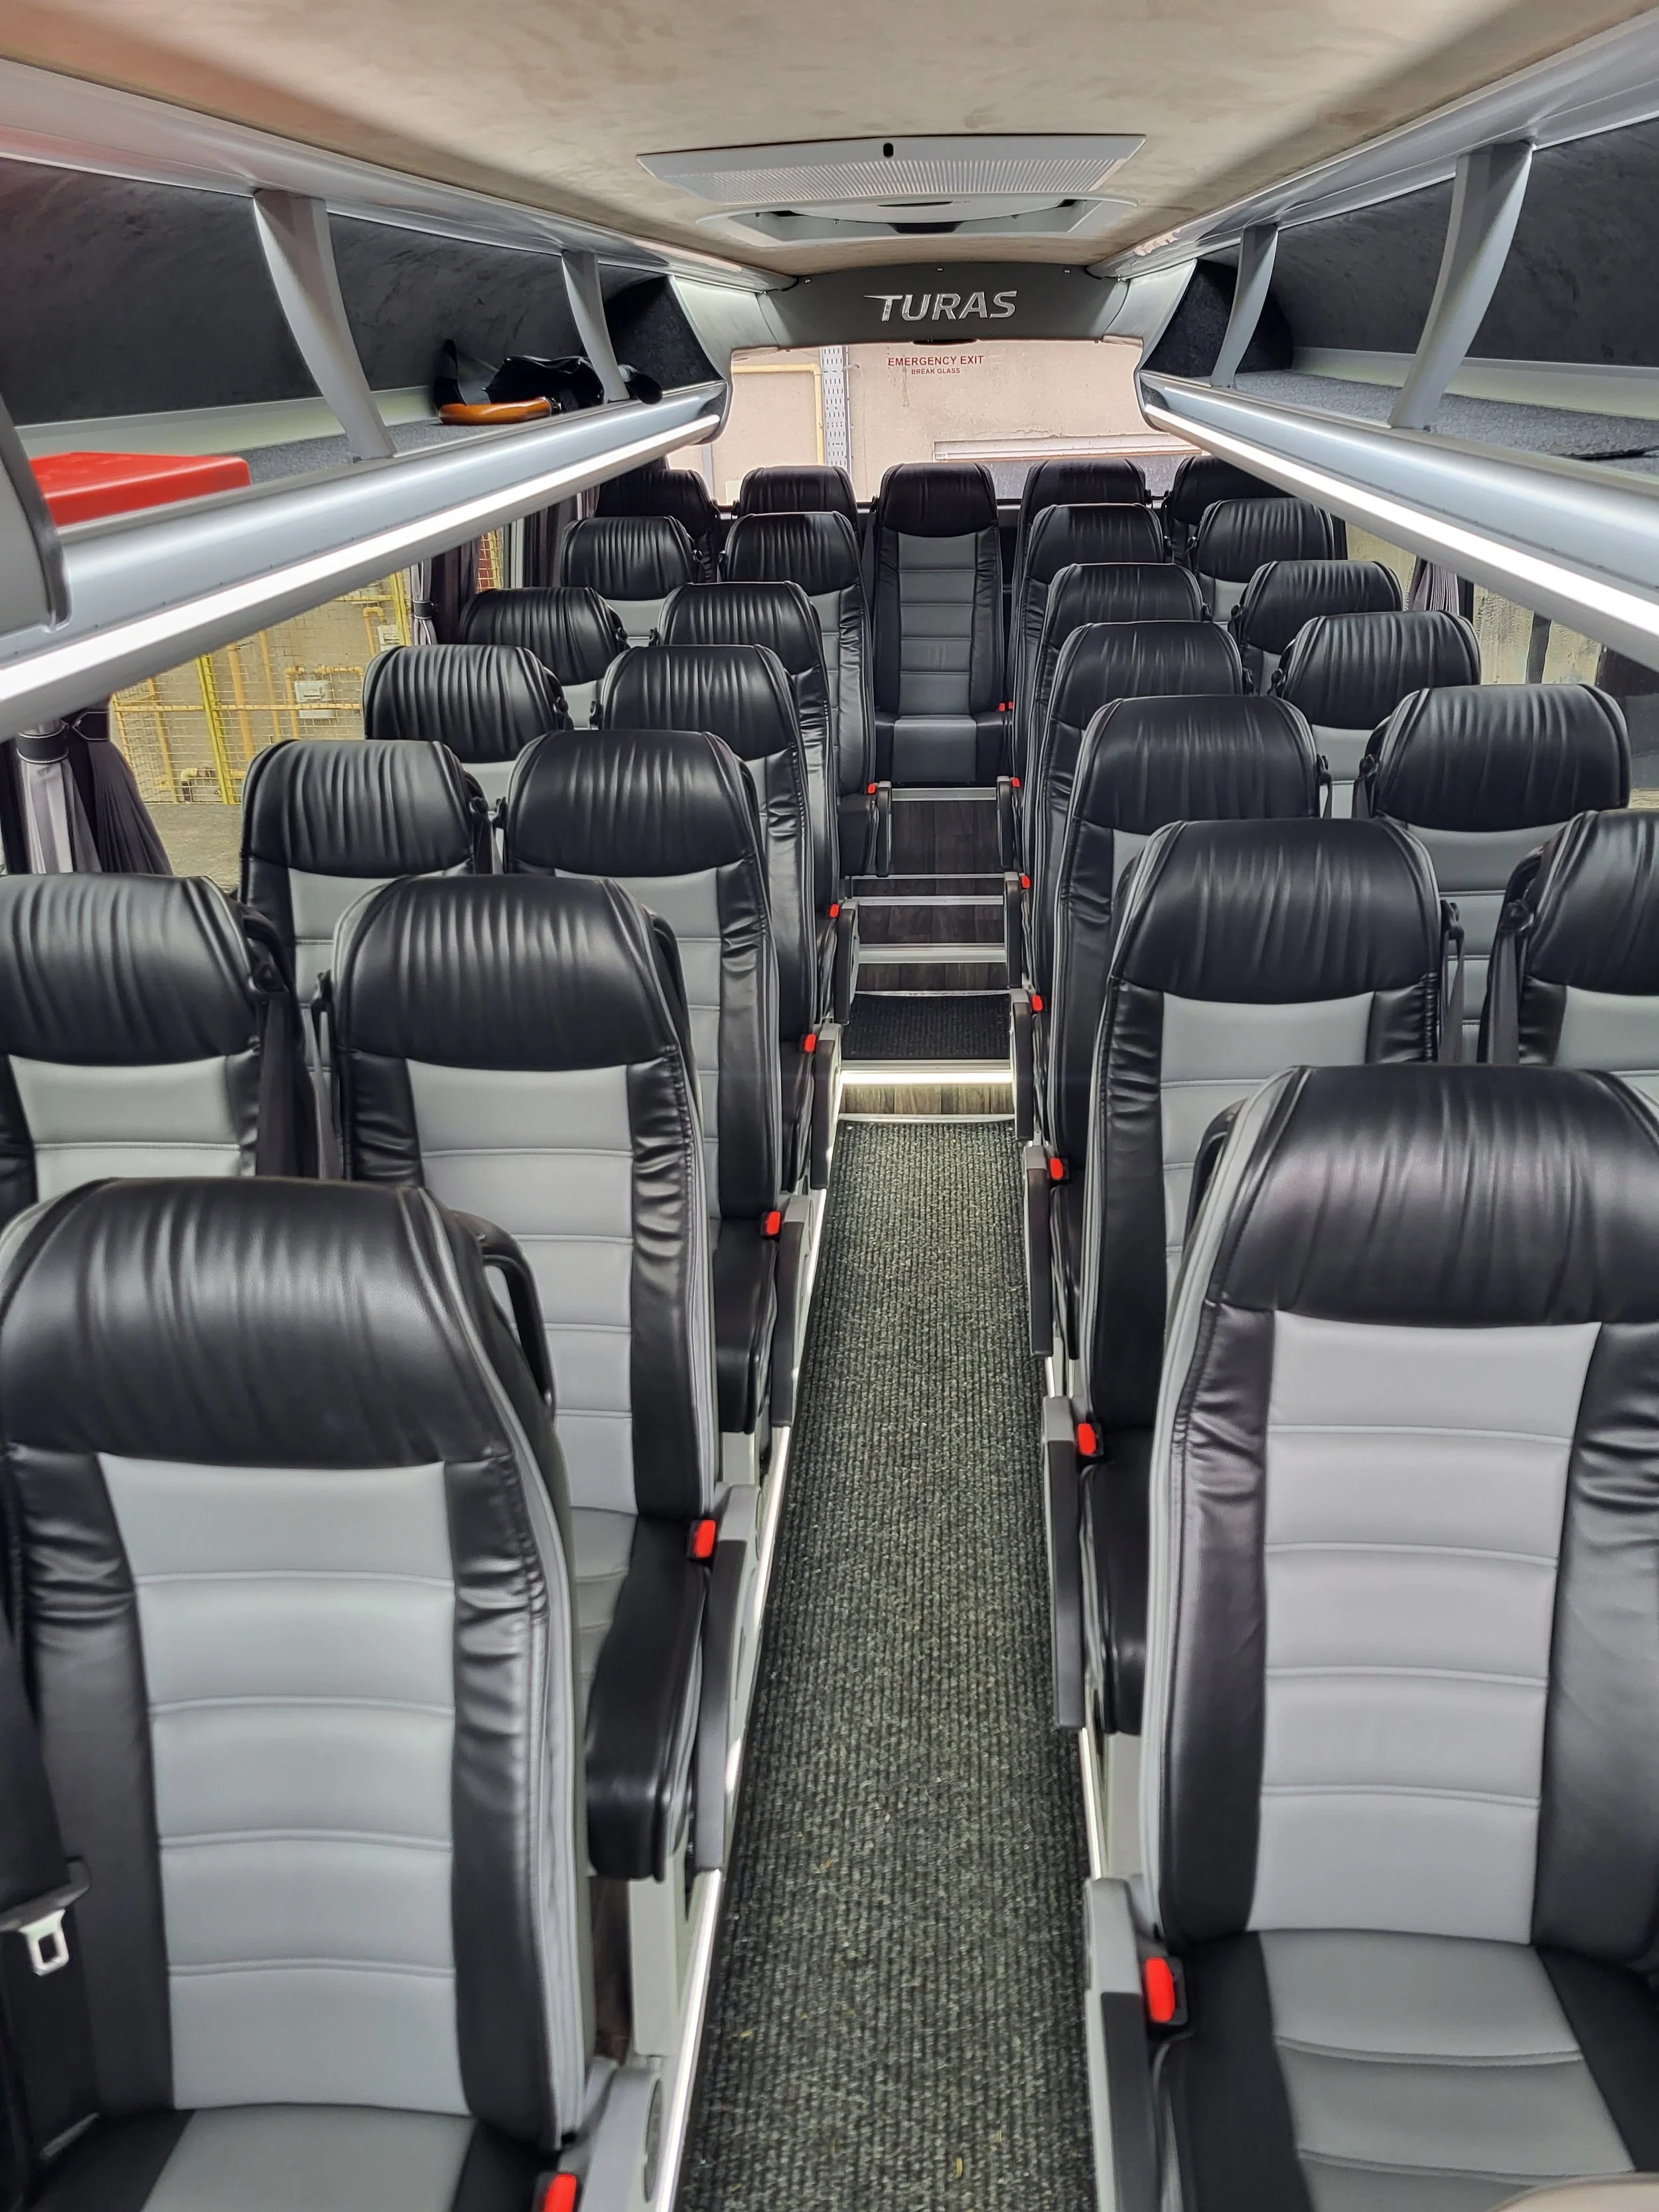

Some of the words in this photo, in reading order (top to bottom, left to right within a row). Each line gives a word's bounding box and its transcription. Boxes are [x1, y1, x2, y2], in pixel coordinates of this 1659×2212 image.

[864, 291, 1018, 322] TURAS
[887, 356, 957, 366] EMERGENCY
[960, 355, 984, 364] EXIT
